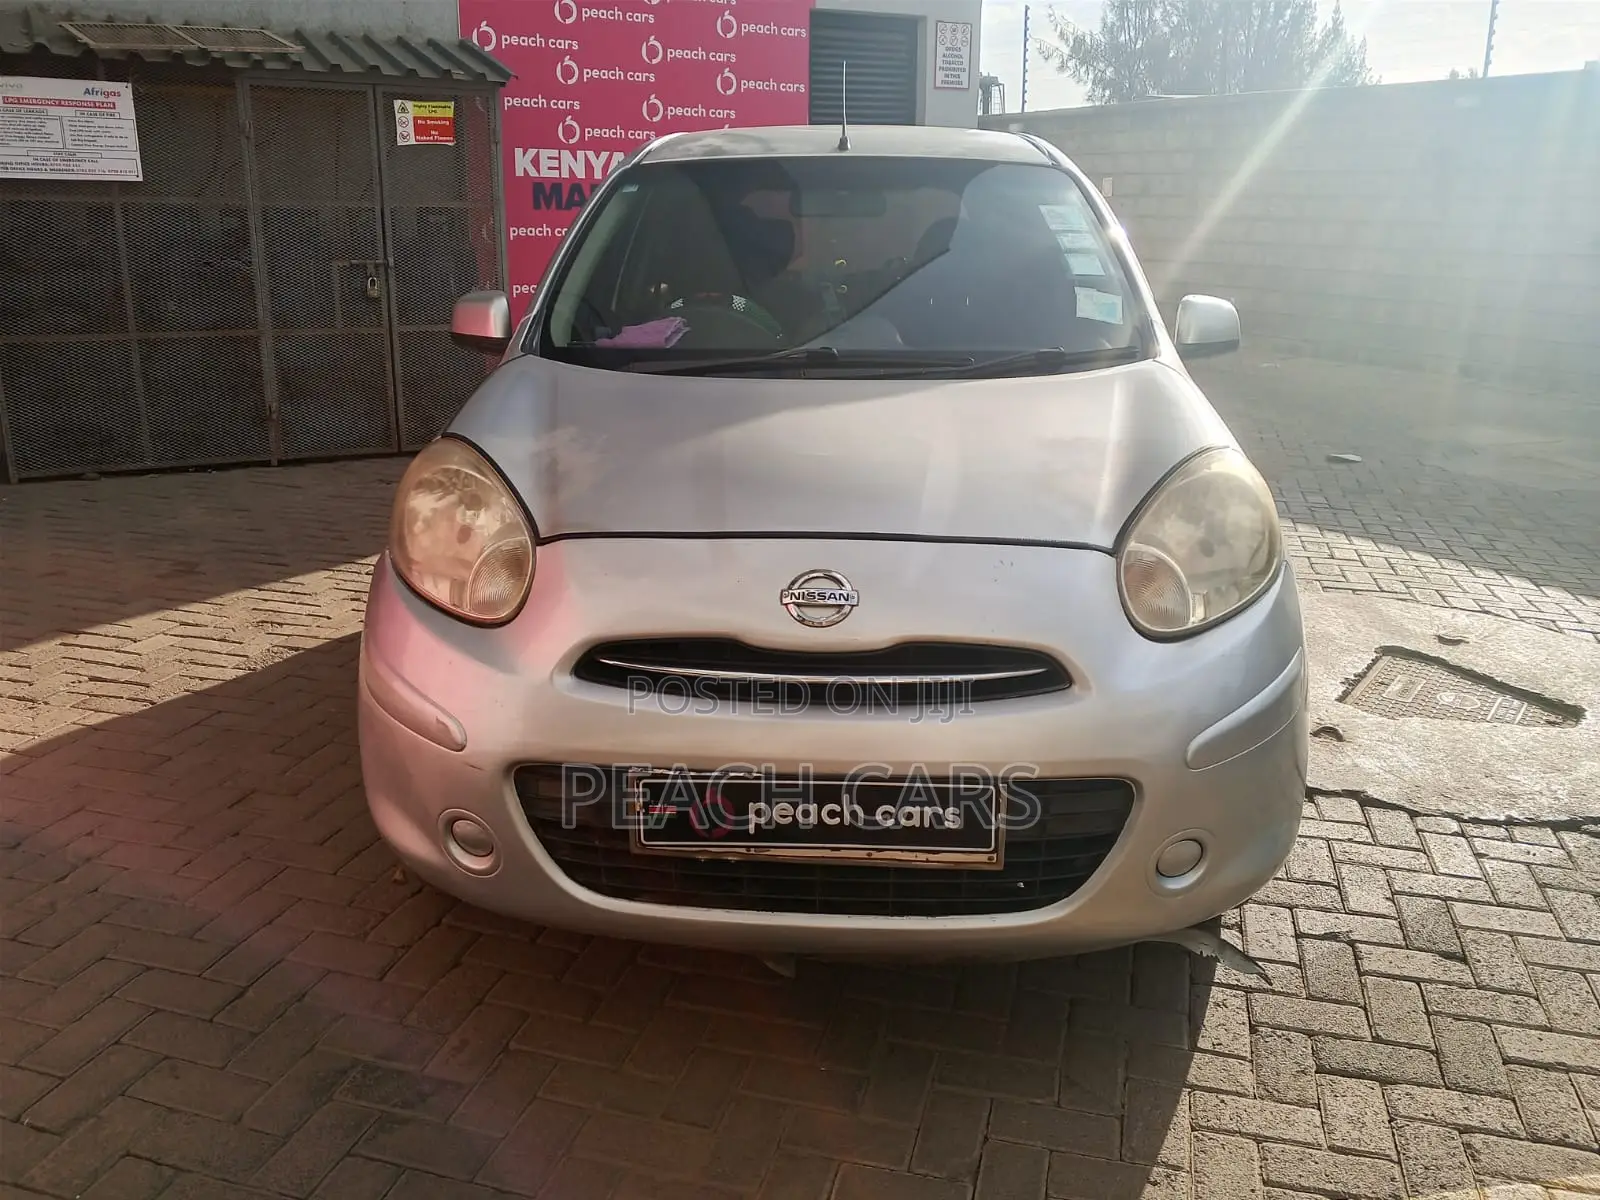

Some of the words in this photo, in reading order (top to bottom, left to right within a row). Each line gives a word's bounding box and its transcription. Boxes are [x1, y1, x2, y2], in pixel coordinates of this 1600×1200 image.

[582, 6, 623, 22] peach
[626, 12, 655, 23] cars
[741, 22, 778, 36] peach
[780, 26, 807, 38] cars
[501, 33, 545, 49] peach
[548, 38, 579, 50] cars
[667, 47, 706, 62] peach
[709, 51, 736, 63] cars
[583, 66, 624, 82] peach
[627, 70, 656, 82] cars
[83, 87, 122, 99] Afrigas
[741, 79, 777, 93] peach
[780, 82, 806, 93] cars
[60, 99, 94, 107] RESPONSE
[504, 94, 547, 110] peach
[550, 98, 580, 110] cars
[667, 104, 706, 119] peach
[709, 108, 736, 119] cars
[584, 124, 625, 141] peach
[628, 129, 656, 140] cars
[532, 182, 600, 211] MA
[509, 224, 552, 240] peach
[512, 284, 537, 298] pea
[790, 591, 850, 602] NISSAN
[748, 794, 864, 834] peach
[875, 804, 962, 829] cars
